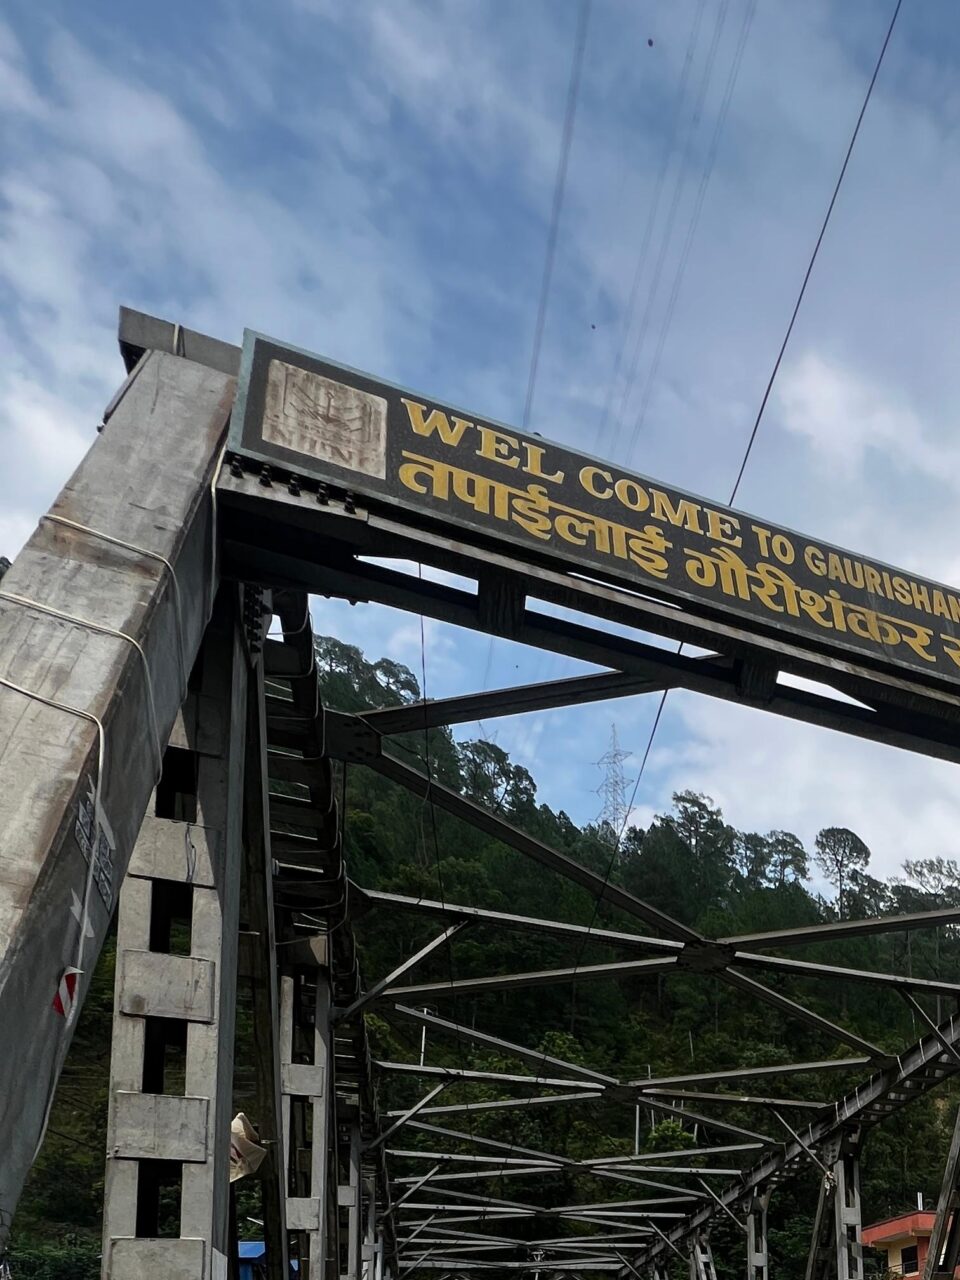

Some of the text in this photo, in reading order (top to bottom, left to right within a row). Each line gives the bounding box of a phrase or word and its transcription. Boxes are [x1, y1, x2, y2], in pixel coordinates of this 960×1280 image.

[578, 465, 743, 548] COME
[751, 525, 795, 565] TO
[683, 546, 937, 663] गौरीशंकर
